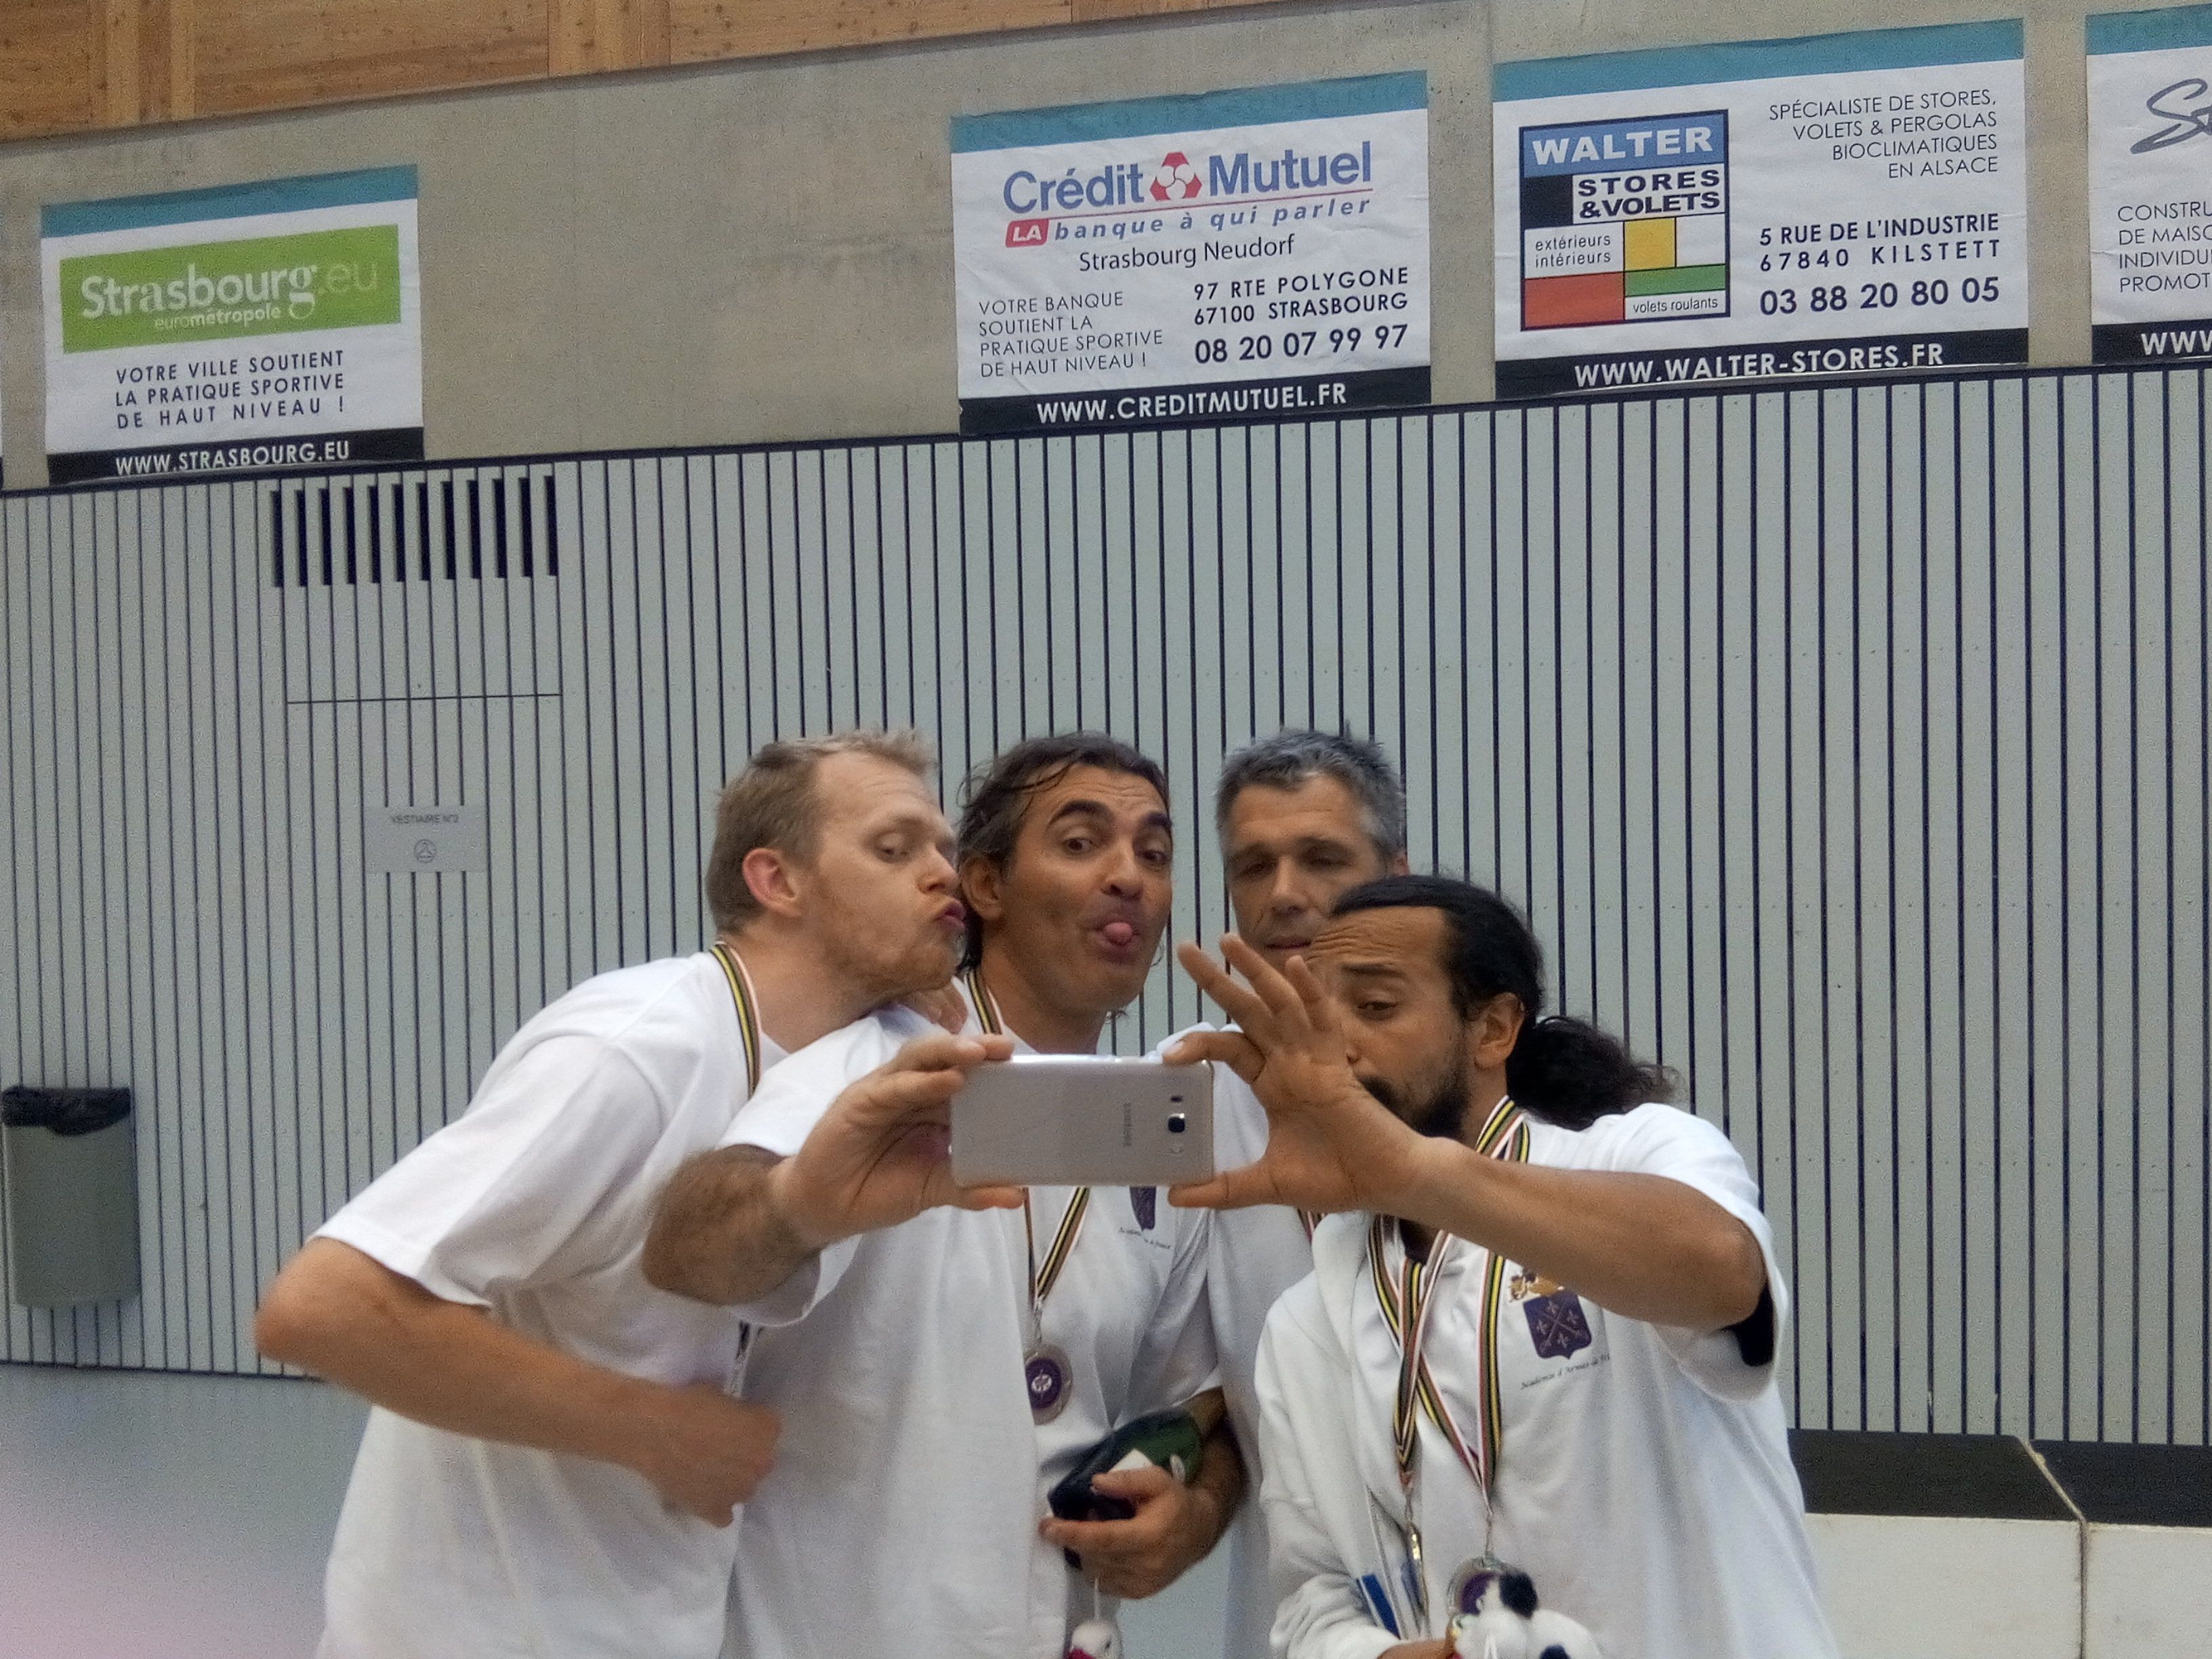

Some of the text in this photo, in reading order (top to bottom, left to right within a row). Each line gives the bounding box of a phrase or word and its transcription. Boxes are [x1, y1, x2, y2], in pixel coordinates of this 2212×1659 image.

[1769, 89, 1996, 121] SPÉCIALISTE DE STORES,
[1793, 111, 1996, 140] VOLETS & PERGOLAS
[1532, 126, 1713, 165] WALTER
[1832, 134, 1997, 161] BIOCLIMATIQUES
[1003, 140, 1372, 214] Crédit Mutuel
[1578, 170, 1720, 197] STORES
[1888, 156, 1998, 179] EN ALSACE
[1012, 197, 1370, 243] LA banque à qui parler
[1579, 192, 1721, 219] &VOLETS
[1535, 232, 1612, 251] extérieurs
[1761, 213, 1999, 245] 5 RUE DE L'INDUSTRIE
[2119, 229, 2144, 245] DE
[1080, 234, 1295, 272] Strasbourg Neudorf
[1535, 249, 1612, 269] intérieurs
[1760, 239, 2000, 271] 67840 KILSTETT
[2119, 249, 2212, 269] INDIVIDU
[1193, 268, 1408, 300] 97 RTE POLYGONE
[1760, 276, 1999, 315] 03 88 20 80 05
[155, 304, 281, 330] eurométropole
[979, 291, 1124, 315] VOTRE BANQUE
[1193, 291, 1408, 326] 67100 STRASBOURG
[1633, 295, 1718, 313] volets roulants
[979, 315, 1092, 337] SOUTIENT LA
[981, 330, 1163, 358] PRATIQUE SPORTIVE
[1195, 324, 1408, 363] 08 20 07 99 97
[117, 350, 344, 384] VOTRE VILLE SOUTIENT
[981, 352, 1147, 377] DE HAUT NIVEAU !
[1575, 342, 1944, 387] WWW.WALTER-STORES.FR
[116, 373, 344, 407] LA PRATIQUE SPORTIVE
[1037, 382, 1347, 424] WWW.CREDITMUTUEL.FR
[117, 396, 344, 430] DE HAUT NIVEAU !
[116, 441, 350, 476] WWW.STRASBOURG.EU
